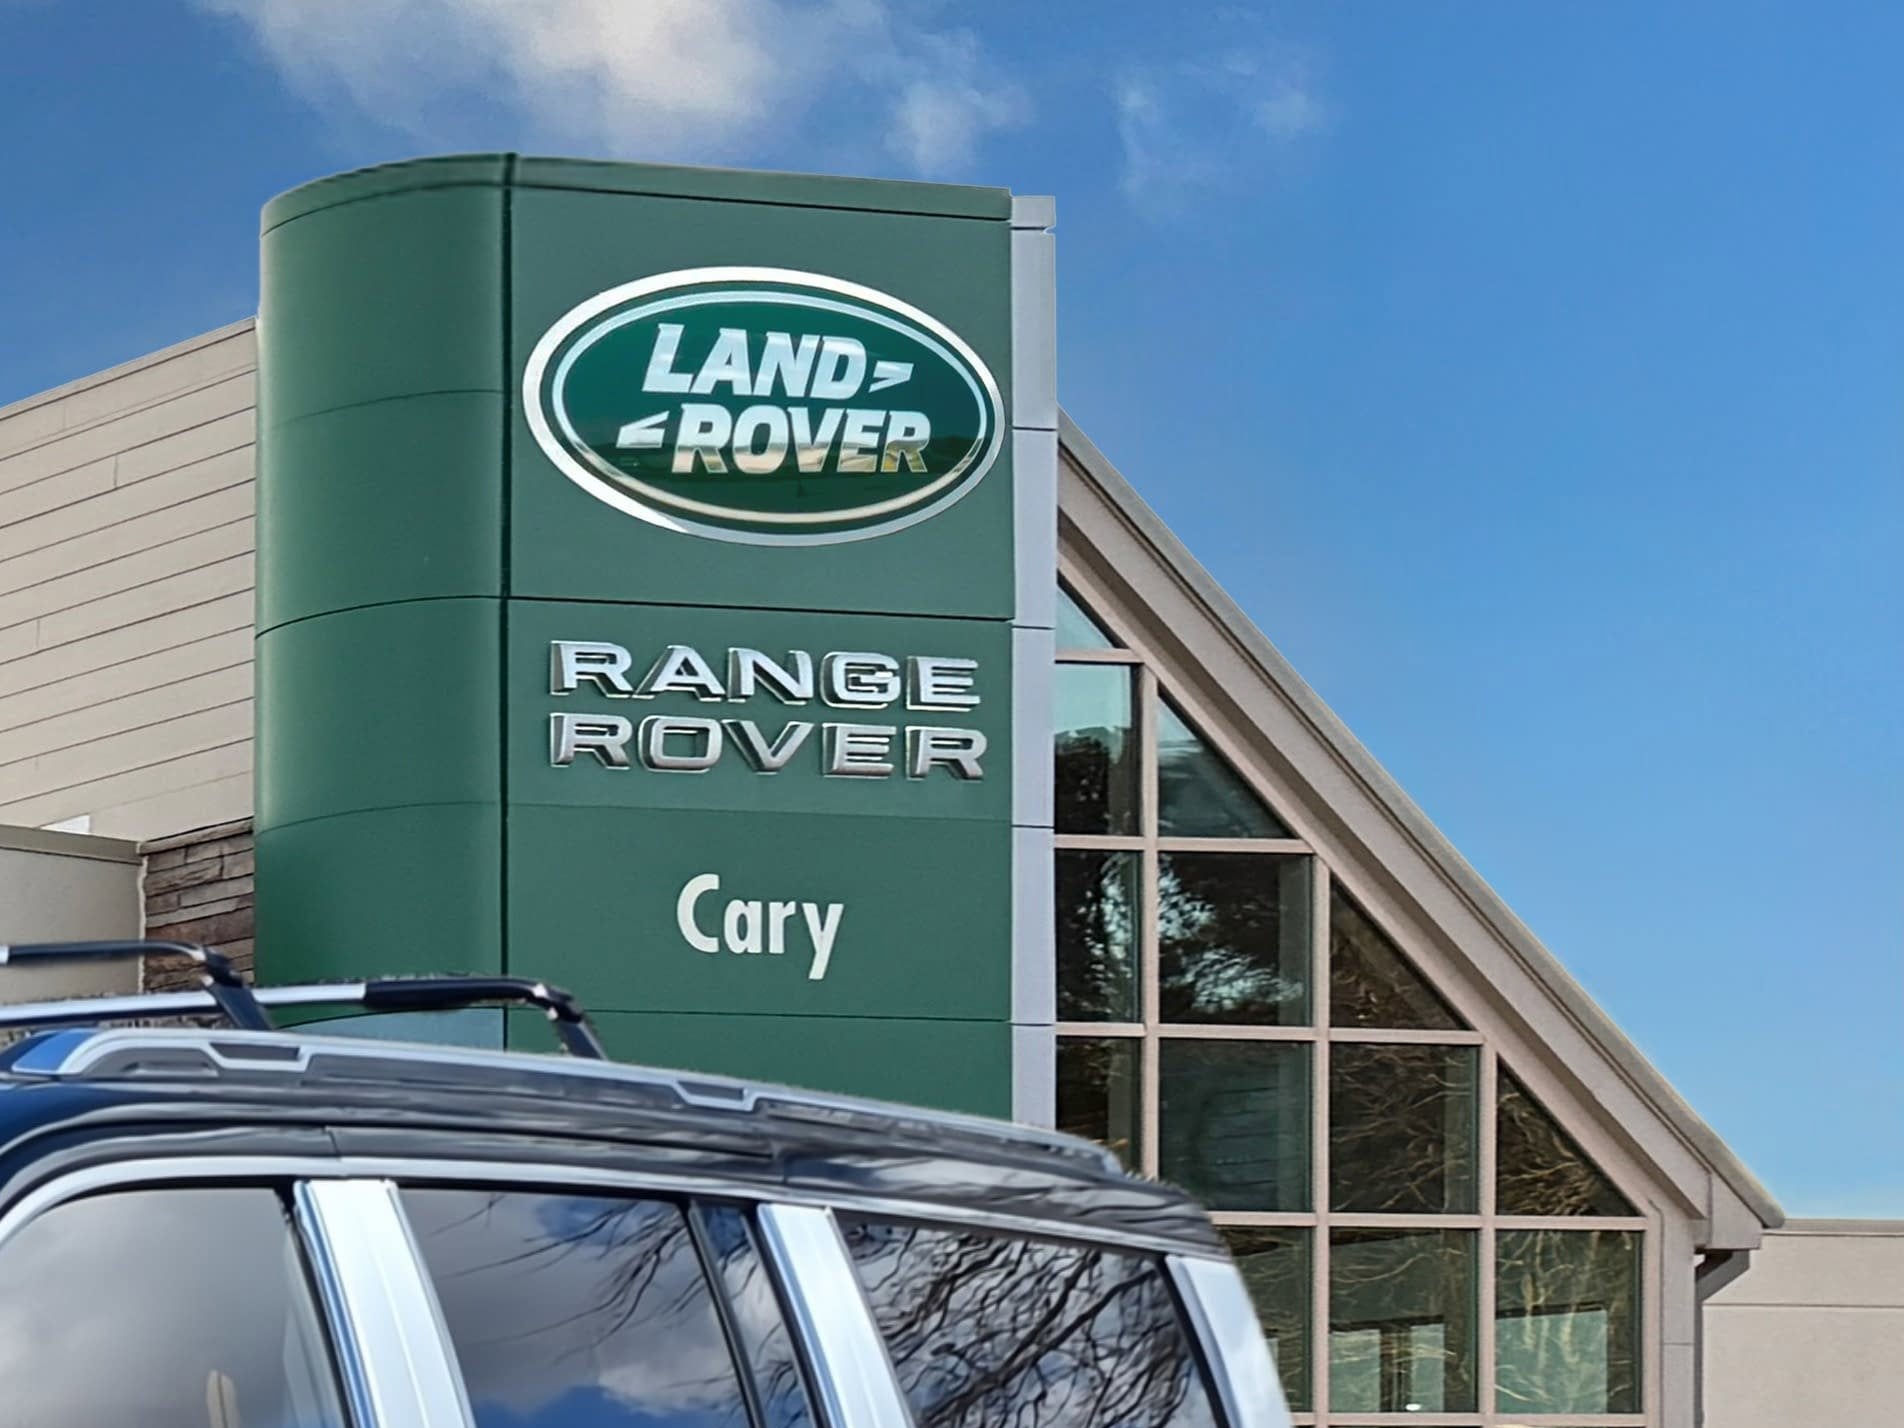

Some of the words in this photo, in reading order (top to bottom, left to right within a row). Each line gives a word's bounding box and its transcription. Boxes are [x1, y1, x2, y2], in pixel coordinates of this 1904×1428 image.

[642, 323, 867, 400] LAND
[672, 403, 932, 474] ROVER
[550, 639, 981, 711] RANGE
[550, 712, 988, 780] ROVER
[676, 873, 845, 980] Cary
